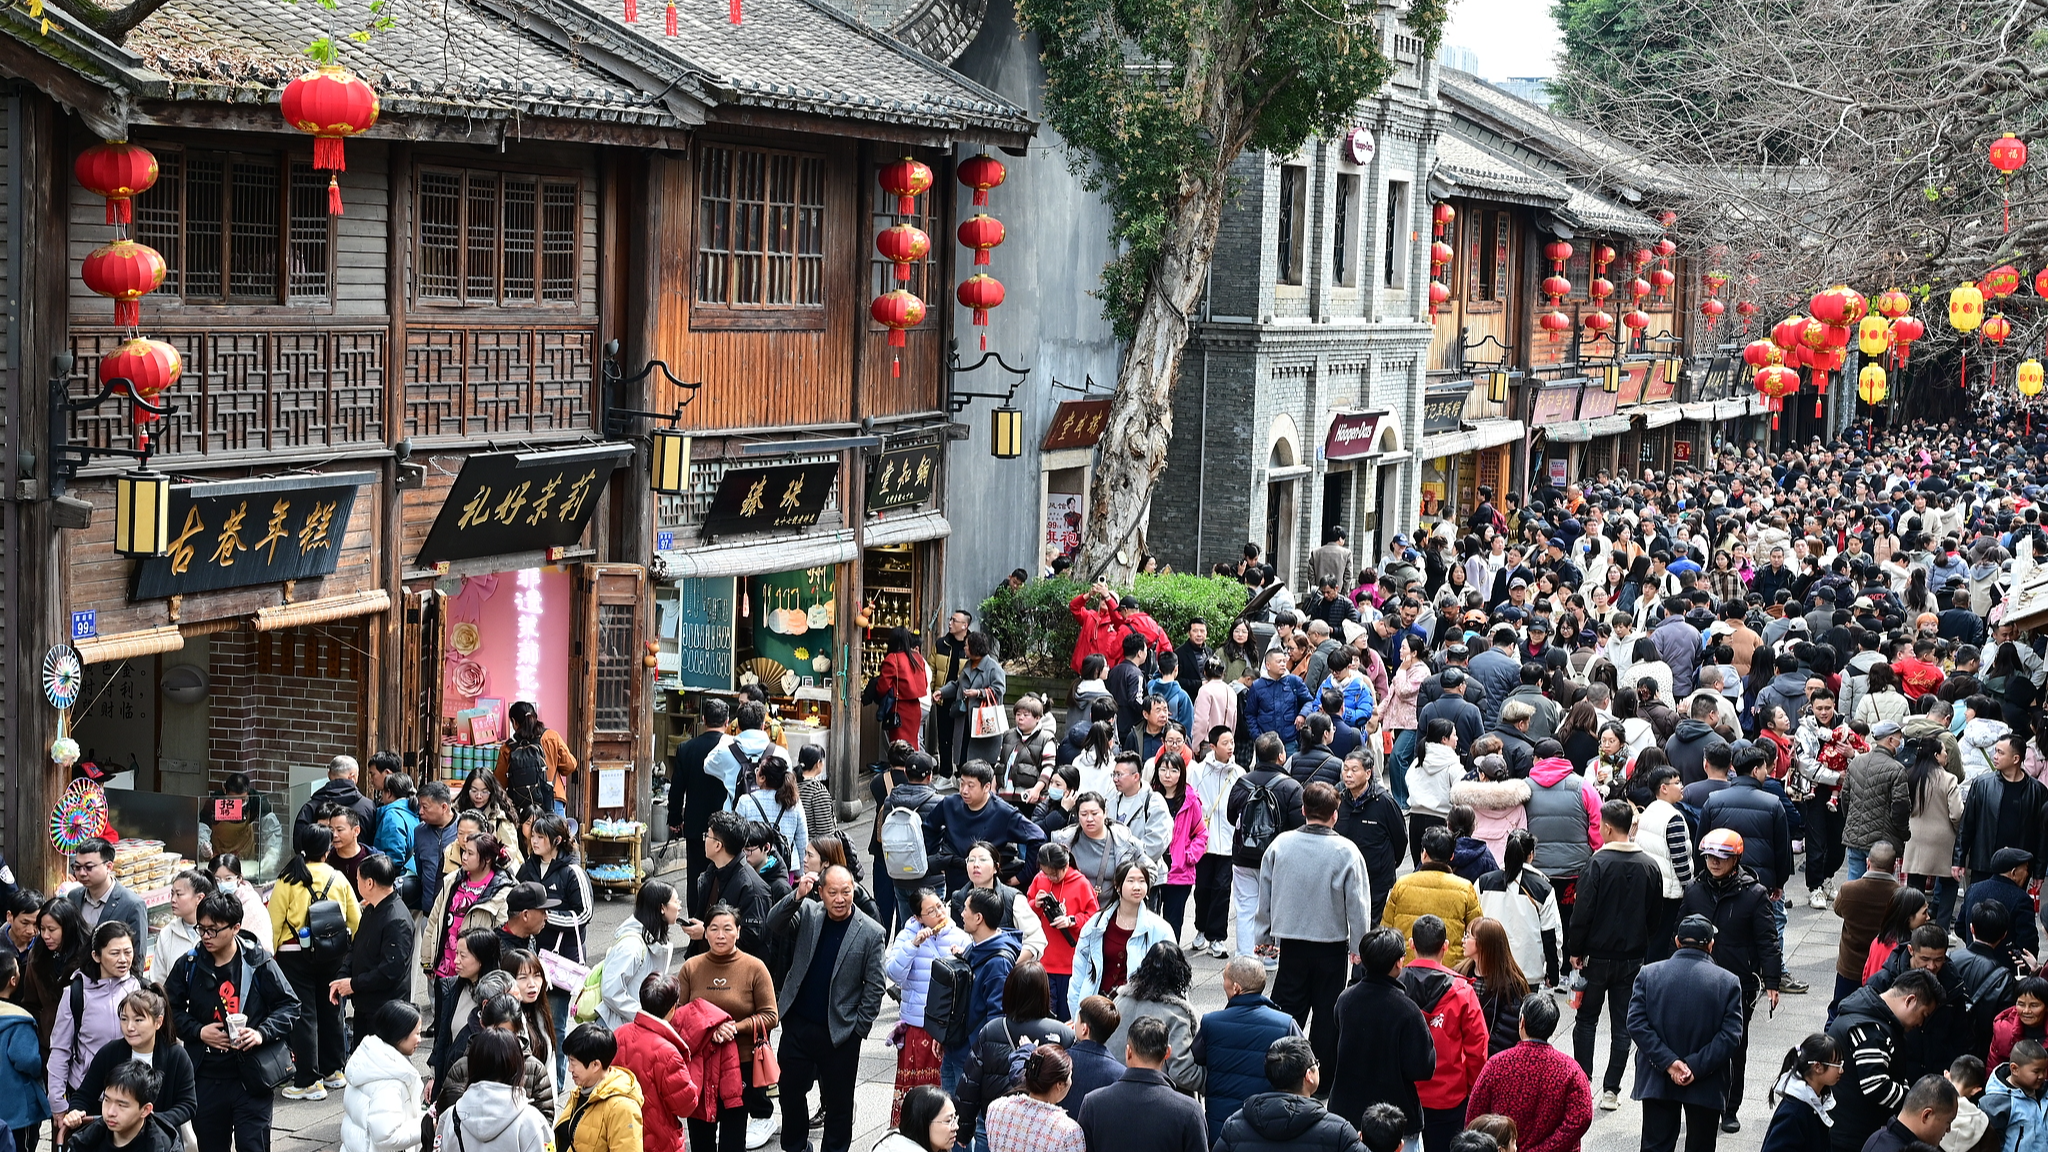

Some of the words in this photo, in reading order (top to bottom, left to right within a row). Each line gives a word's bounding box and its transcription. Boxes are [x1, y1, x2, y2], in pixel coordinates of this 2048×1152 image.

[1334, 421, 1373, 446] Häagen-Dazs
[165, 497, 337, 576] 古巷年糕
